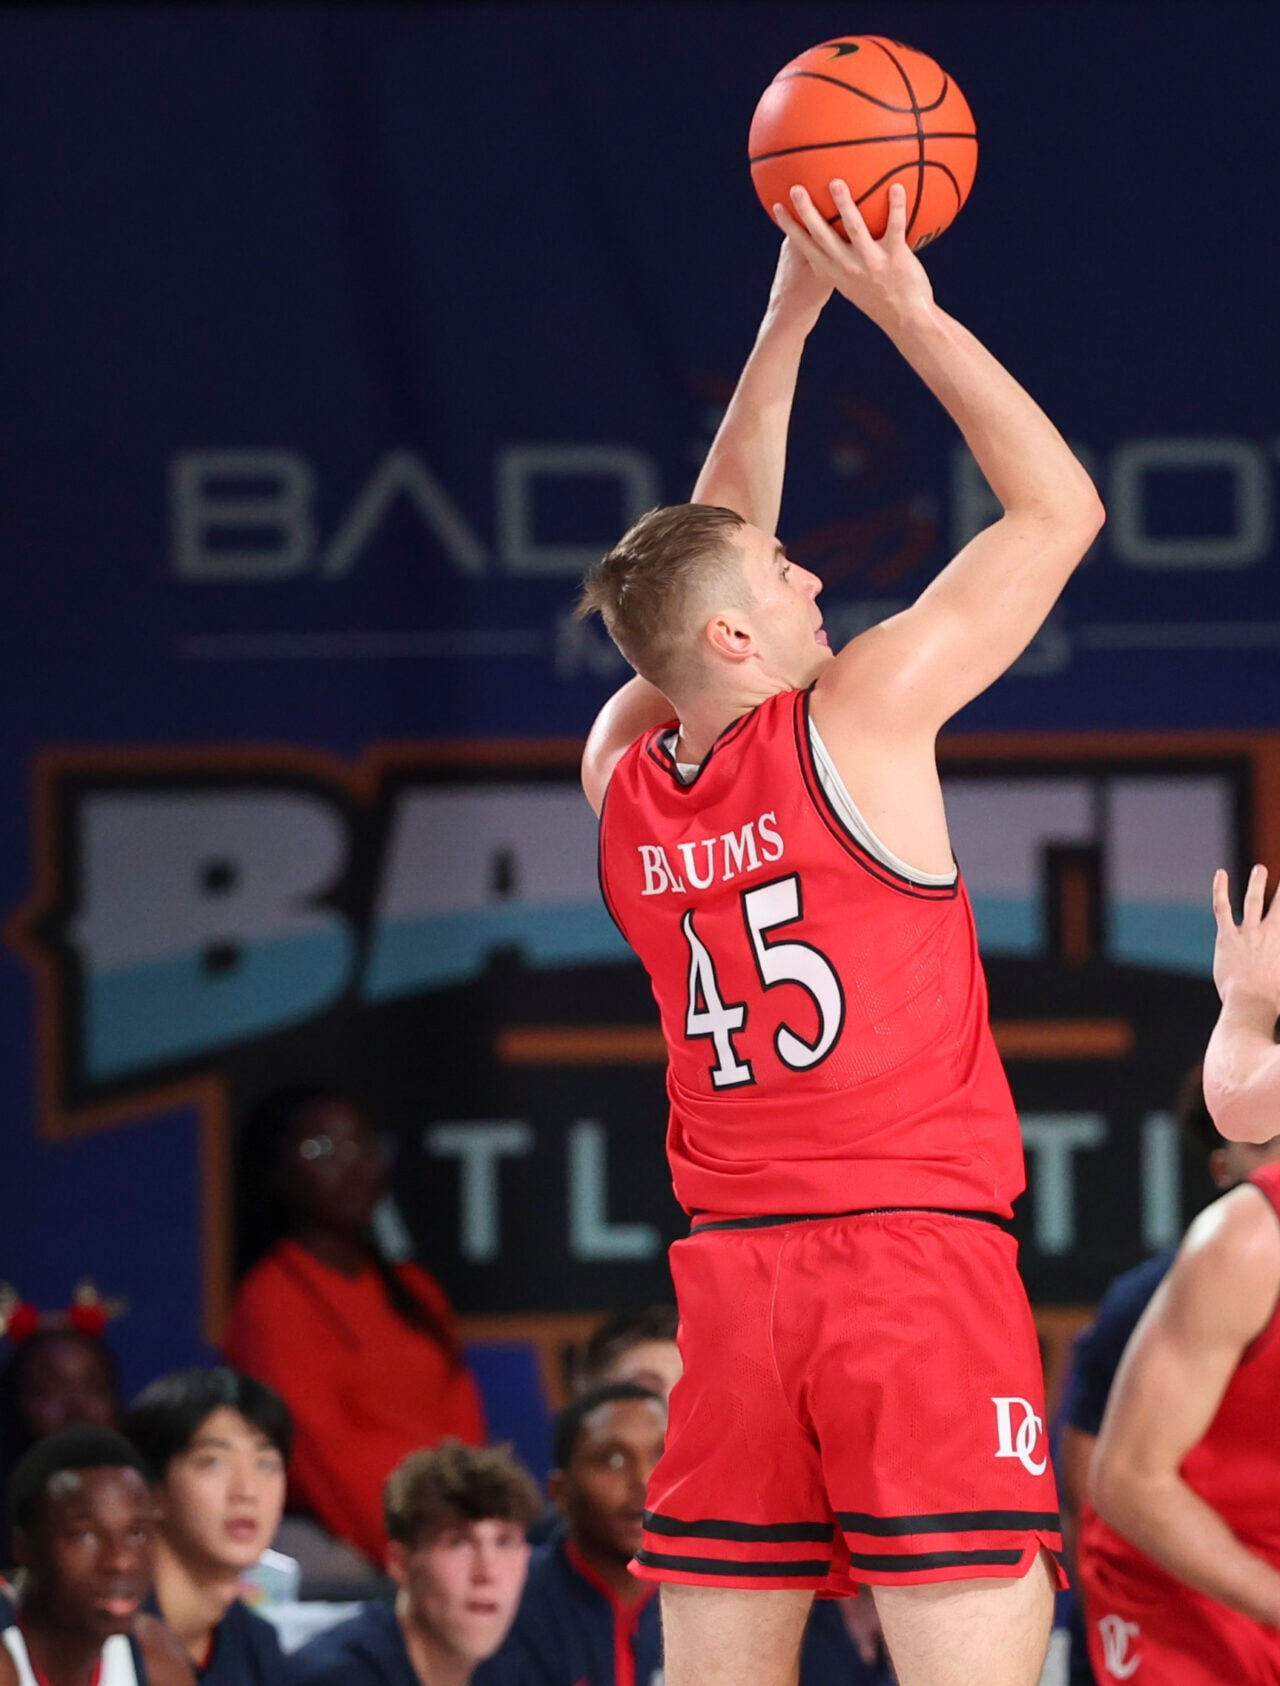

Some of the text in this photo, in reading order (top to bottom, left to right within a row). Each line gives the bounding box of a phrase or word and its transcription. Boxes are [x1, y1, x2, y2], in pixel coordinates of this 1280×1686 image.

[166, 442, 660, 582] BAD
[637, 810, 785, 896] BLUMS
[680, 871, 846, 1092] 45
[991, 1396, 1047, 1476] DC
